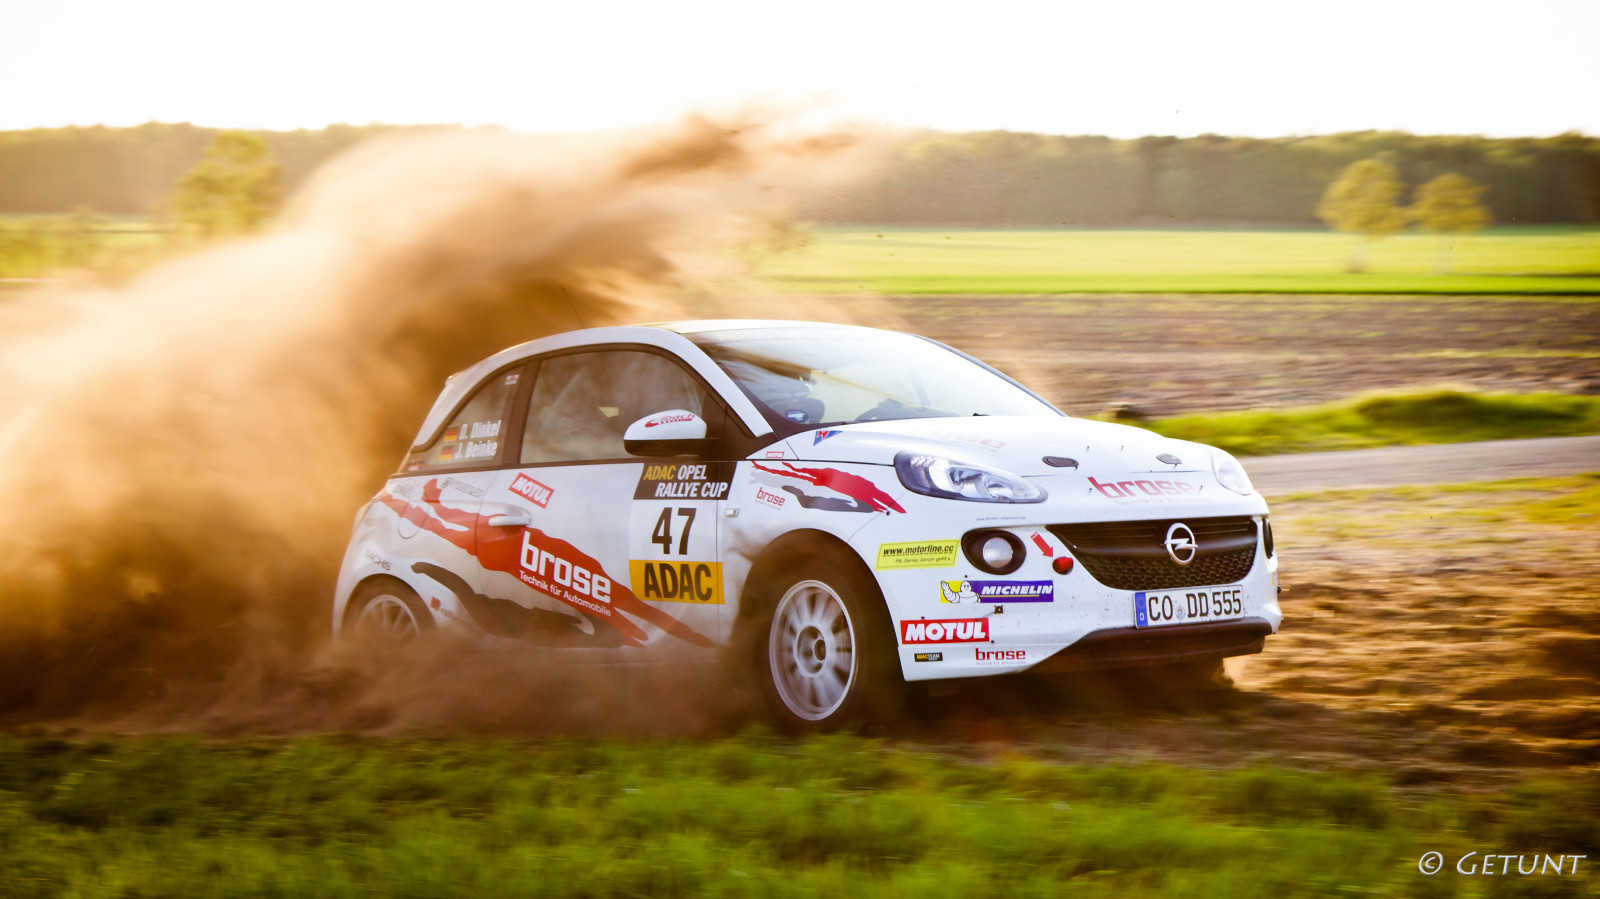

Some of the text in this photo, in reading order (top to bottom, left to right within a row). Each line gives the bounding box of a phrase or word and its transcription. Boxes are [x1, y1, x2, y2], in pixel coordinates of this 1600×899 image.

[469, 419, 502, 439] Dinkel
[454, 440, 498, 460] J. Beinke
[643, 464, 707, 481] ADAC OPEL
[511, 476, 550, 505] MOTUL
[654, 482, 728, 498] RALLYE CUP
[756, 486, 786, 507] brose
[1087, 476, 1197, 499] brose
[651, 507, 697, 556] 47
[883, 545, 955, 556] www.motorline.cc
[519, 530, 611, 604] brose
[644, 562, 713, 601] ADAC
[981, 584, 1053, 595] MICHELIN
[519, 570, 612, 617] Technik für Automobile
[1148, 590, 1242, 621] CO DD 555
[904, 621, 986, 641] MOTUL
[975, 648, 1026, 661] brose
